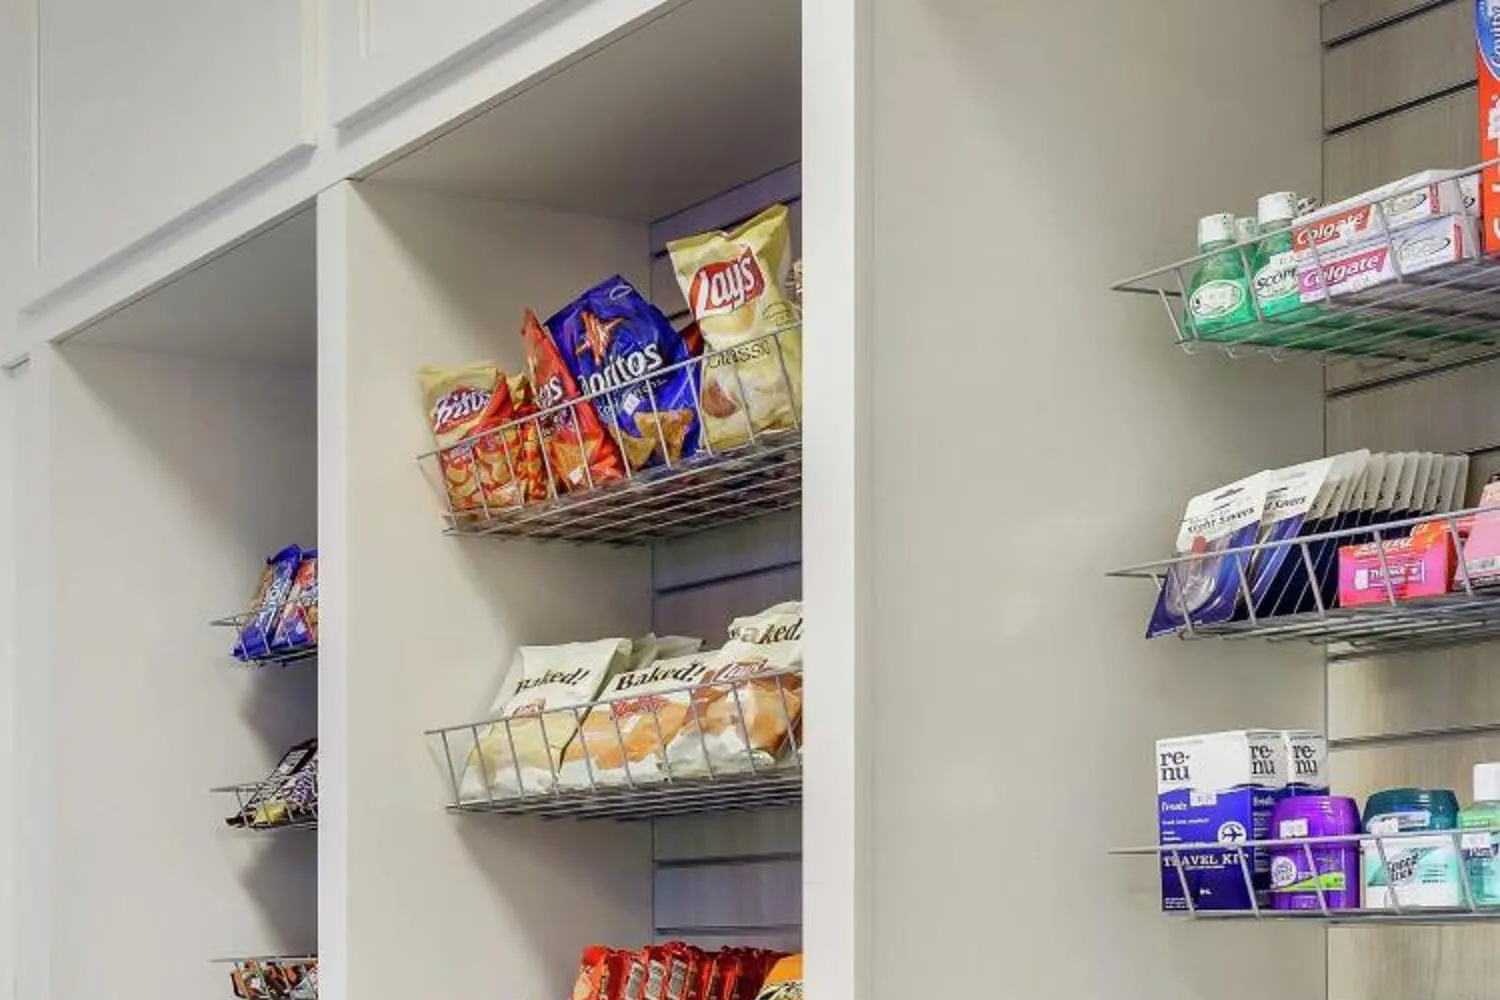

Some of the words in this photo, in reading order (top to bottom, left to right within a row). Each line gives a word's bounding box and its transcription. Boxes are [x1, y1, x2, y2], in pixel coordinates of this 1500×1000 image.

[1304, 254, 1380, 287] Colgate
[695, 256, 755, 321] Lay's
[514, 667, 590, 696] Baked!
[615, 662, 707, 691] Baked!
[1161, 766, 1190, 781] nu
[1252, 760, 1276, 775] nu
